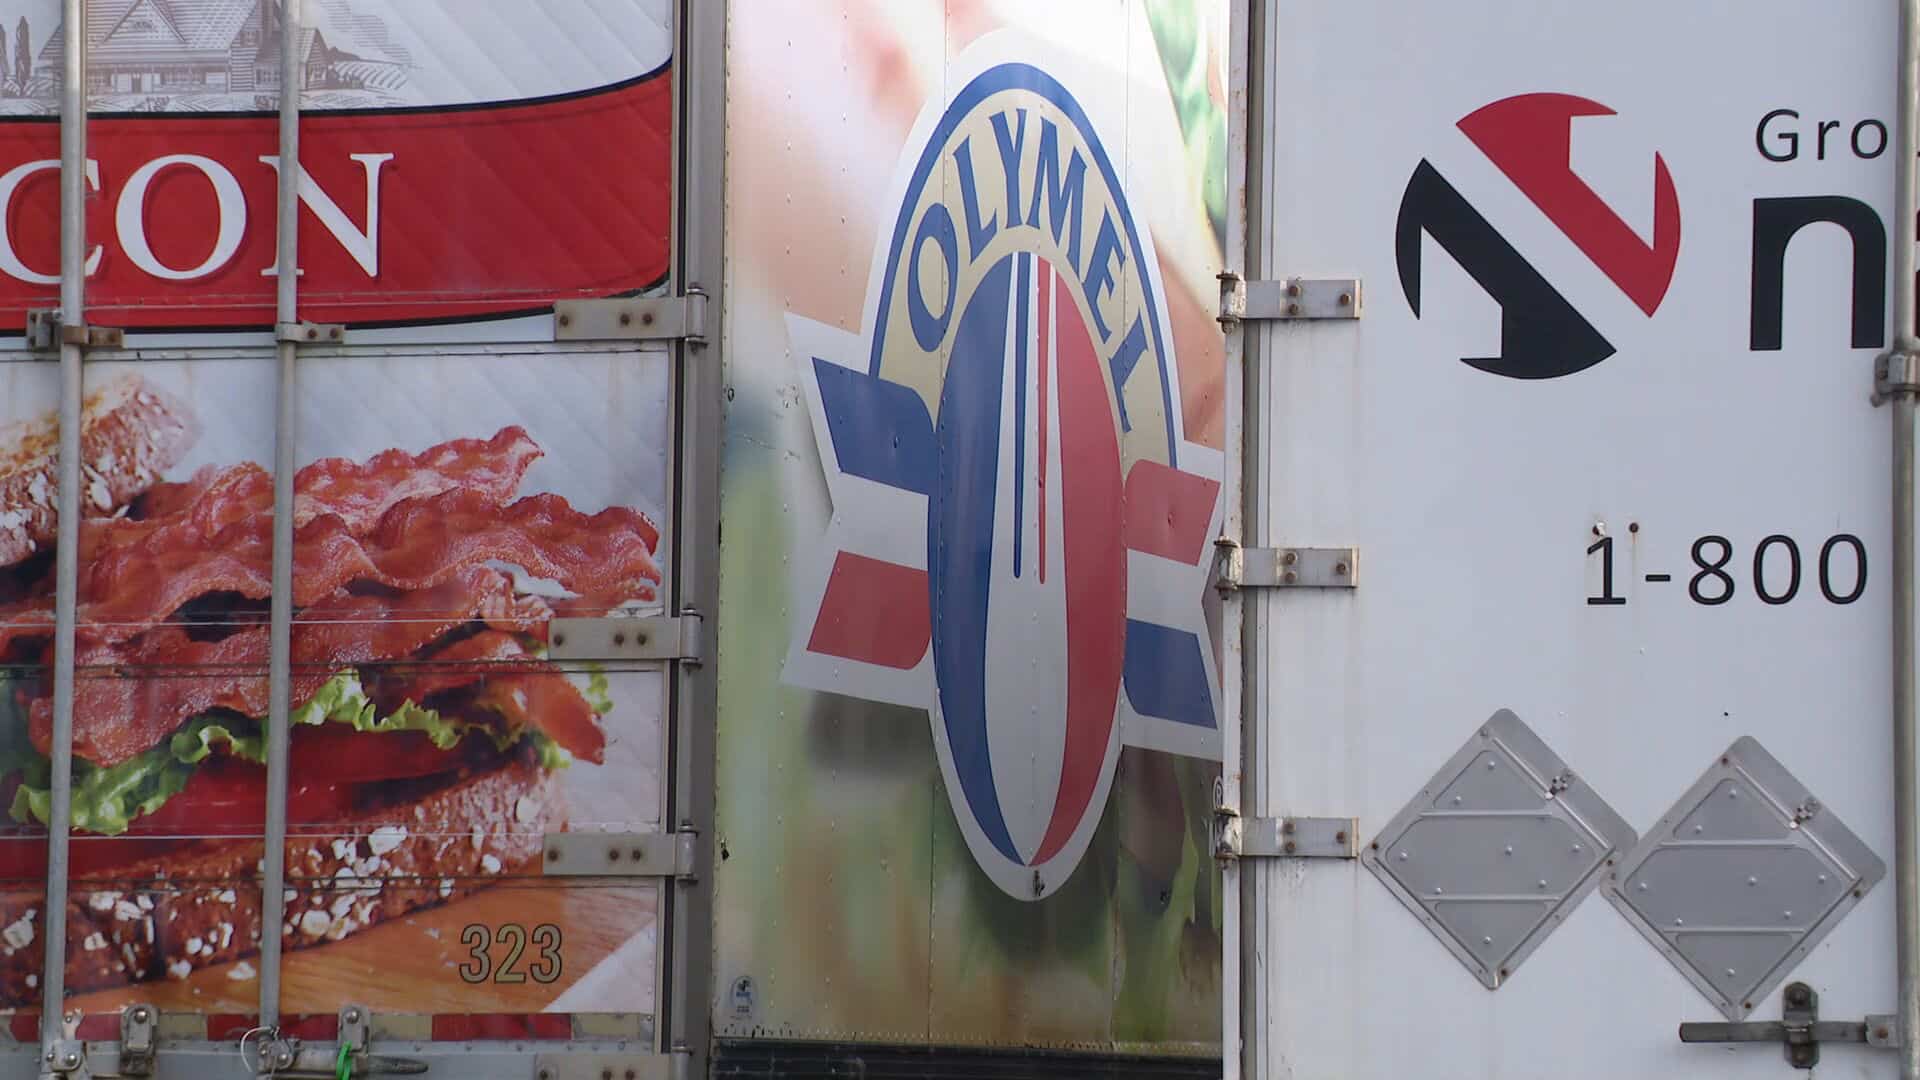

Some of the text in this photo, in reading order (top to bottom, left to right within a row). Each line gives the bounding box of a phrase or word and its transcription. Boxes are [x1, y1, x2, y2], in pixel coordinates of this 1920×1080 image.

[1756, 108, 1920, 162] Gro
[0, 153, 394, 284] CON
[907, 108, 1149, 433] OLYMEL
[1749, 195, 1920, 350] n
[1586, 534, 1868, 605] 1-800
[459, 923, 562, 983] 323
